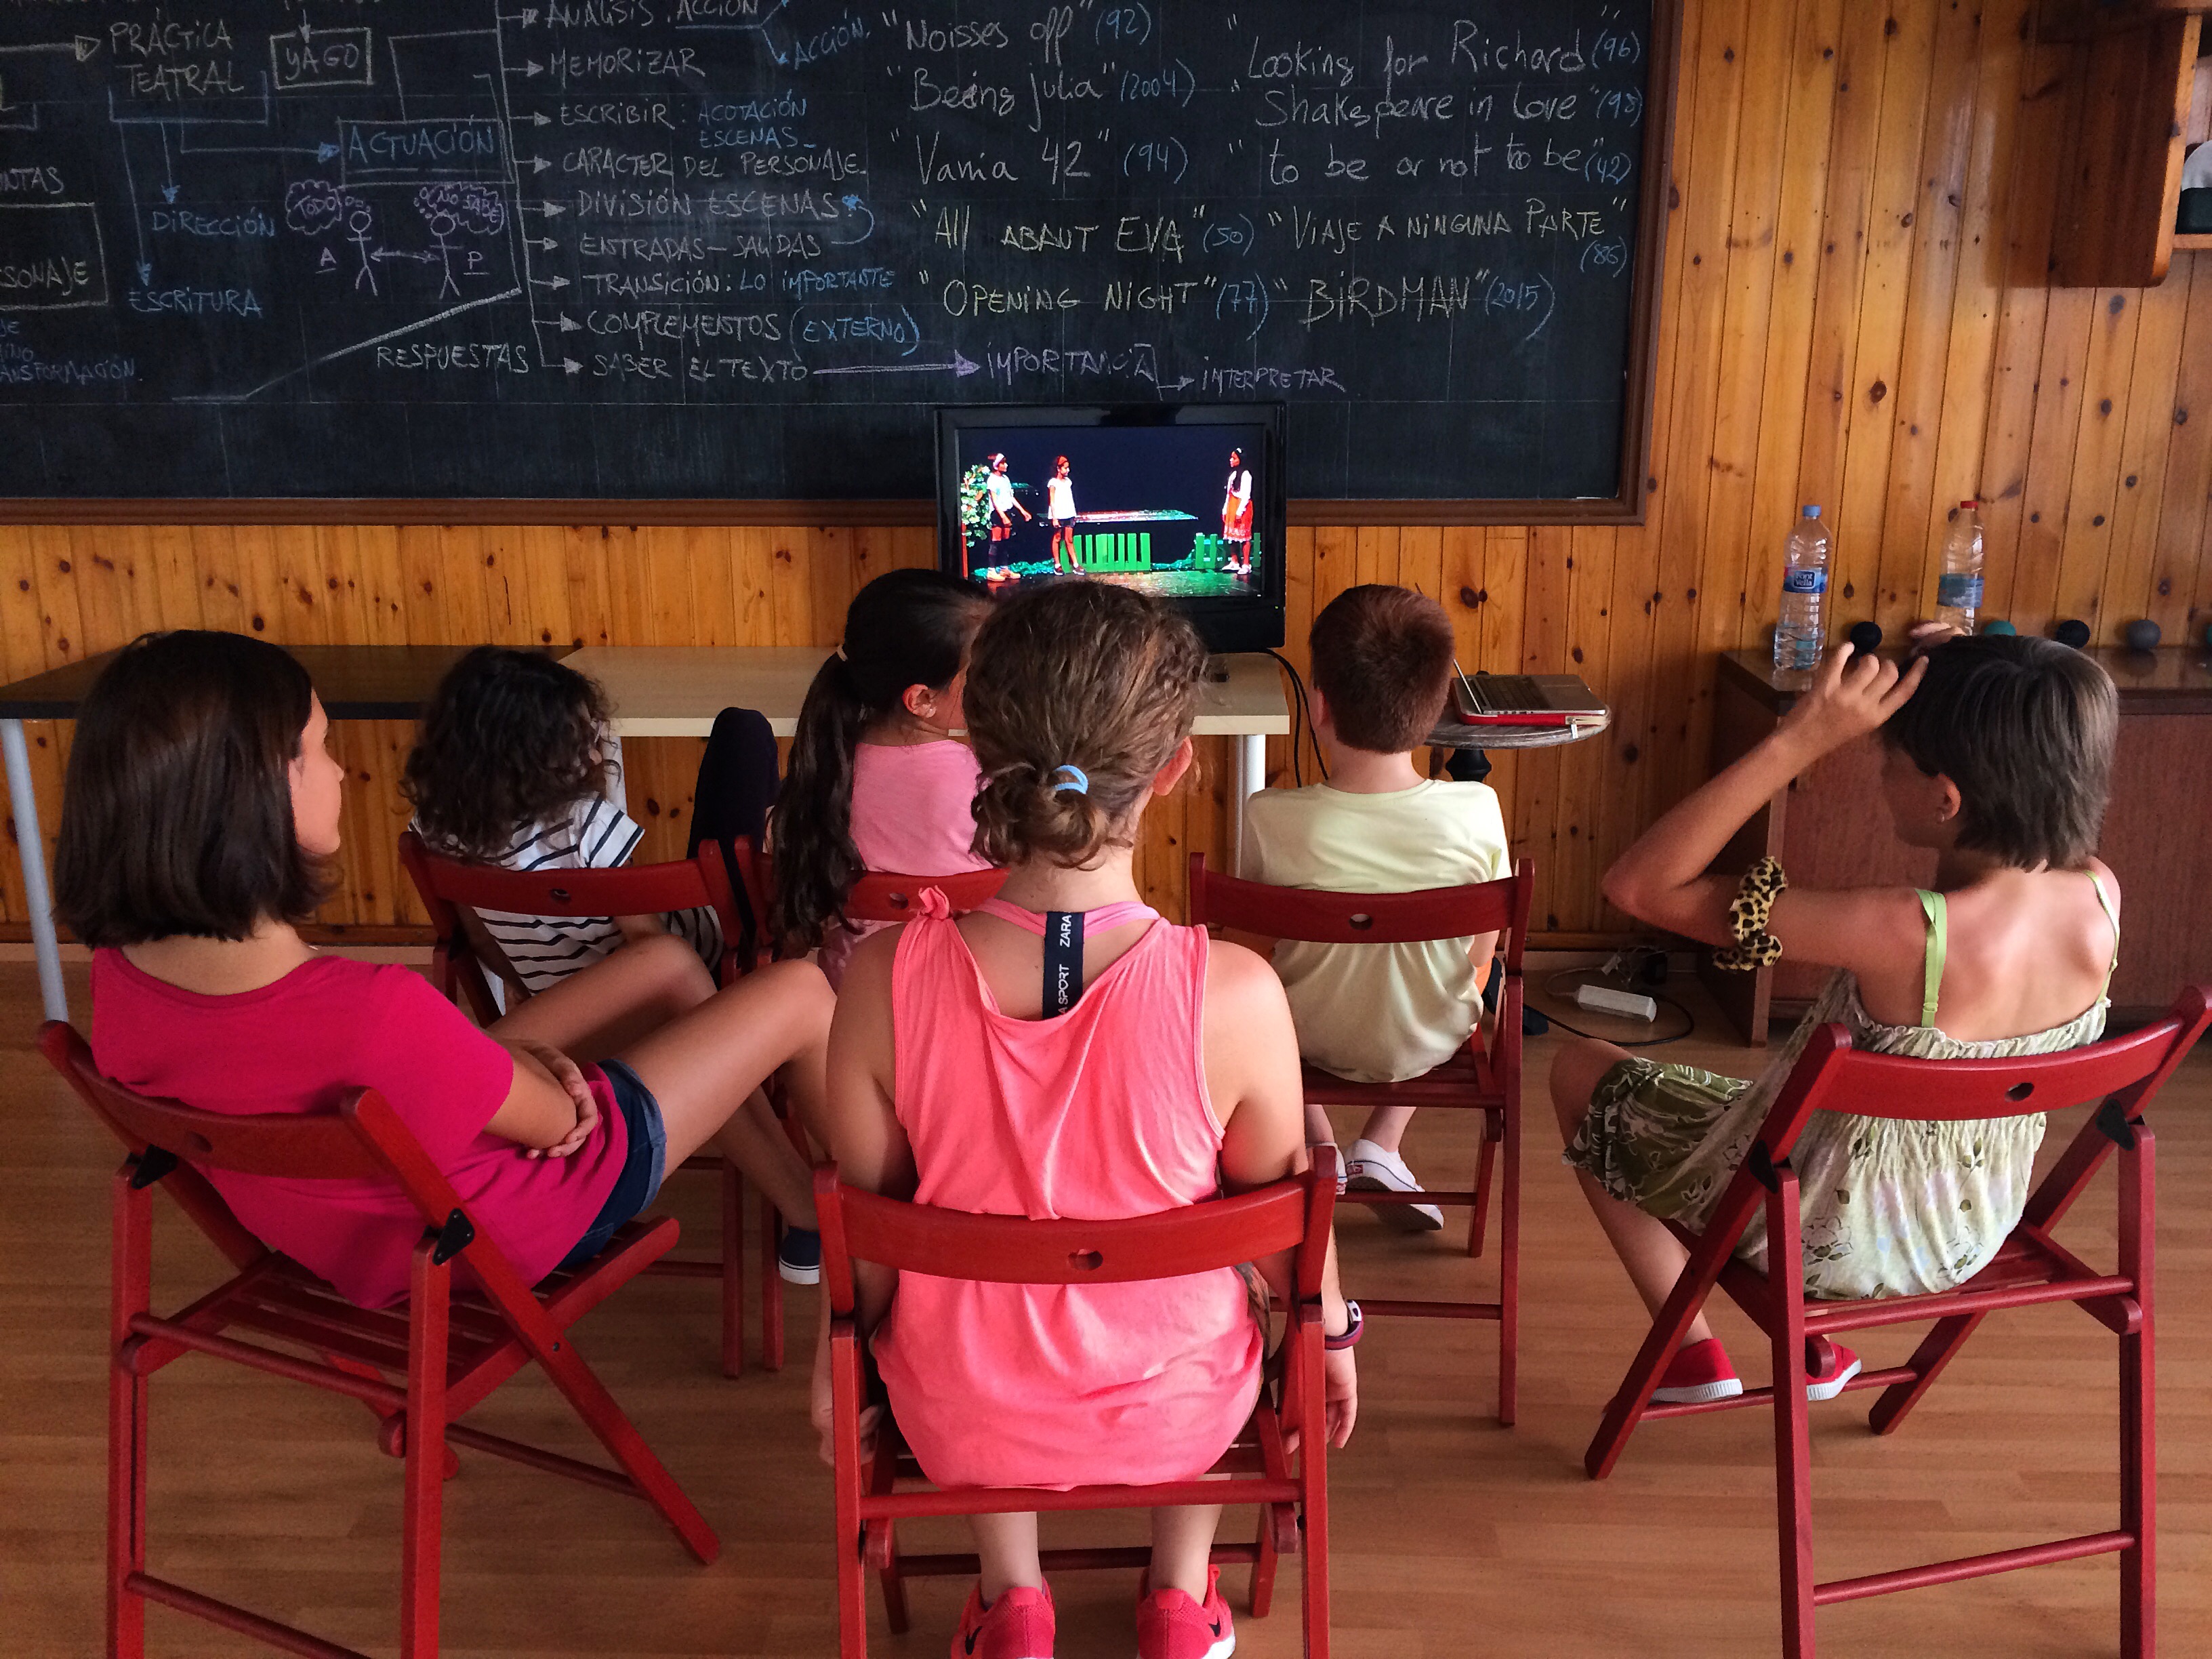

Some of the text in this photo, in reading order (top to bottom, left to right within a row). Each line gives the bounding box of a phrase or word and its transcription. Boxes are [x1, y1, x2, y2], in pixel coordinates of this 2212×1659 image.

[1095, 1, 1151, 46] (92)
[115, 60, 245, 101] TEATRAL
[285, 43, 360, 81] YAGO
[550, 47, 706, 89] MEMORIZAR
[1383, 35, 1429, 102] for
[1592, 28, 1641, 69] (96)
[1121, 58, 1196, 108] (2004)
[1469, 87, 1492, 121] in
[683, 155, 724, 179] DEL
[1124, 136, 1189, 184] (94)
[1326, 144, 1370, 182] be
[1397, 156, 1425, 176] or
[1439, 131, 1492, 177] not
[1507, 132, 1532, 171] to
[1586, 152, 1632, 186] (42)
[1377, 215, 1396, 241] A
[1407, 209, 1513, 239] NINGUNA
[320, 247, 337, 267] A
[467, 251, 484, 270] P
[740, 269, 767, 292] LO
[782, 267, 895, 300] IMPORTANTE
[129, 287, 264, 319] ESCRITURA
[1485, 272, 1556, 341] (2015)
[588, 304, 921, 362] COMPLEMENTOS (EXTERNO)
[377, 342, 529, 373] RESPUESTAS
[592, 352, 672, 382] SABER
[689, 356, 716, 382] EL
[719, 355, 808, 384] TEXTO
[1059, 915, 1072, 948] ZARA
[1058, 964, 1069, 1005] SPORT
